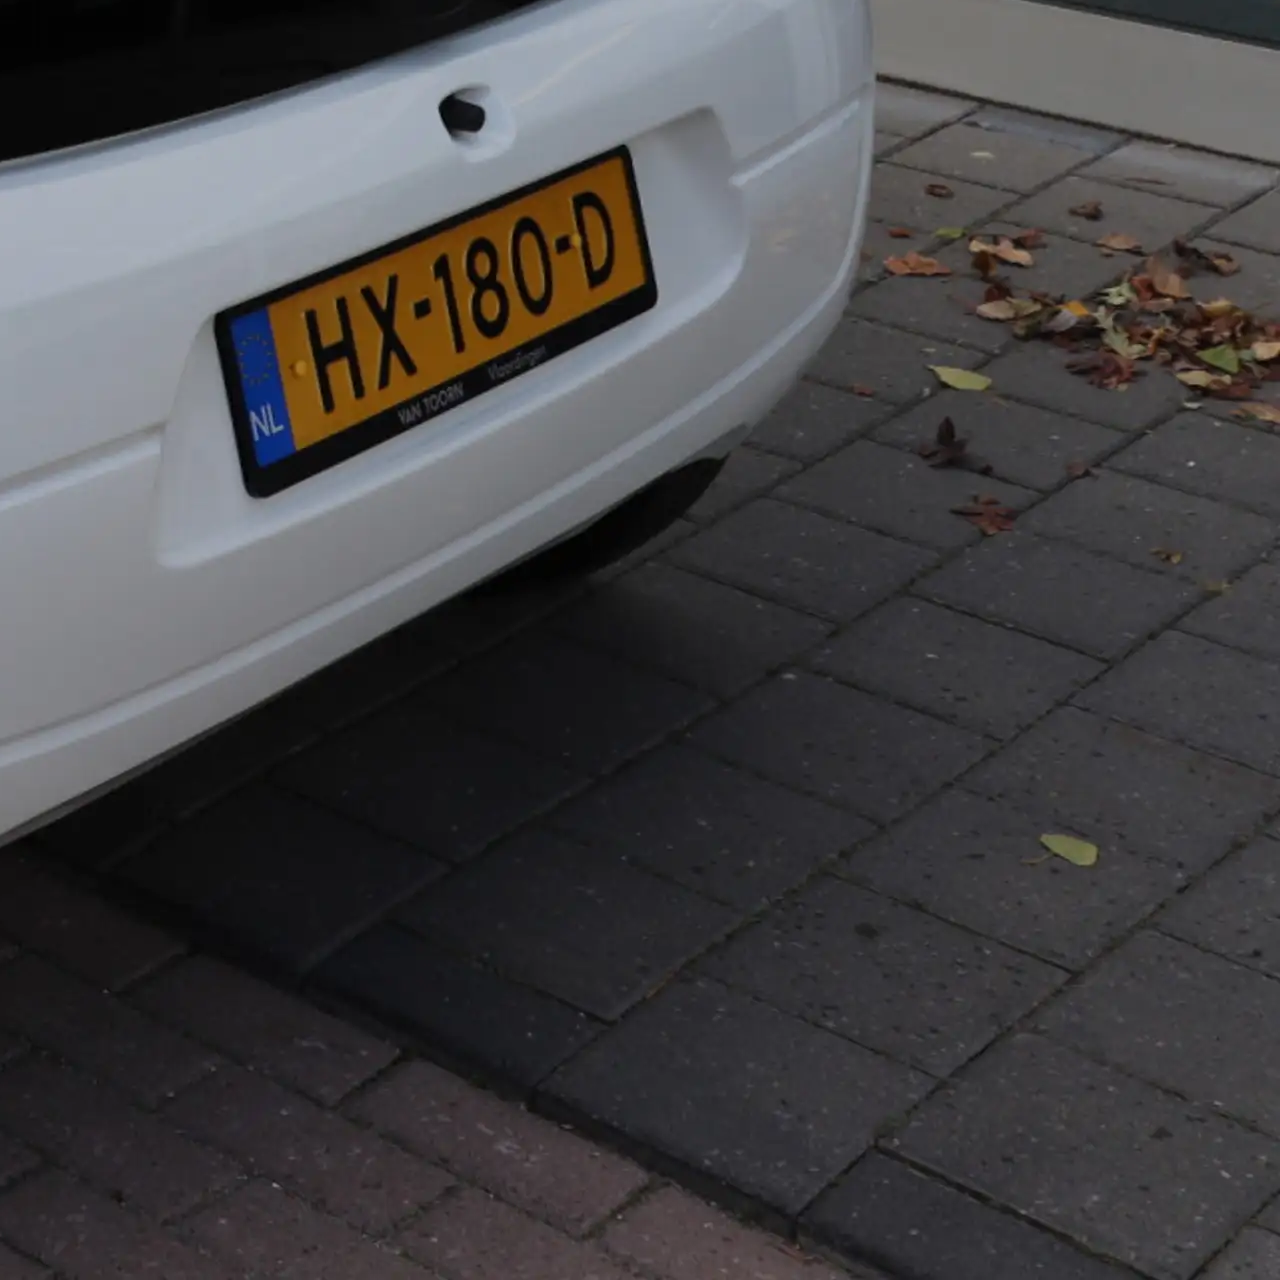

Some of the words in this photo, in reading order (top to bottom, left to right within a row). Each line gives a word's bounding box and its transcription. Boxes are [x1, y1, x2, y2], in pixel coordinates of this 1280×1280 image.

[301, 191, 615, 415] HX-180-D
[249, 402, 285, 442] NL
[397, 402, 423, 426] VAN
[422, 381, 464, 412] TOORN
